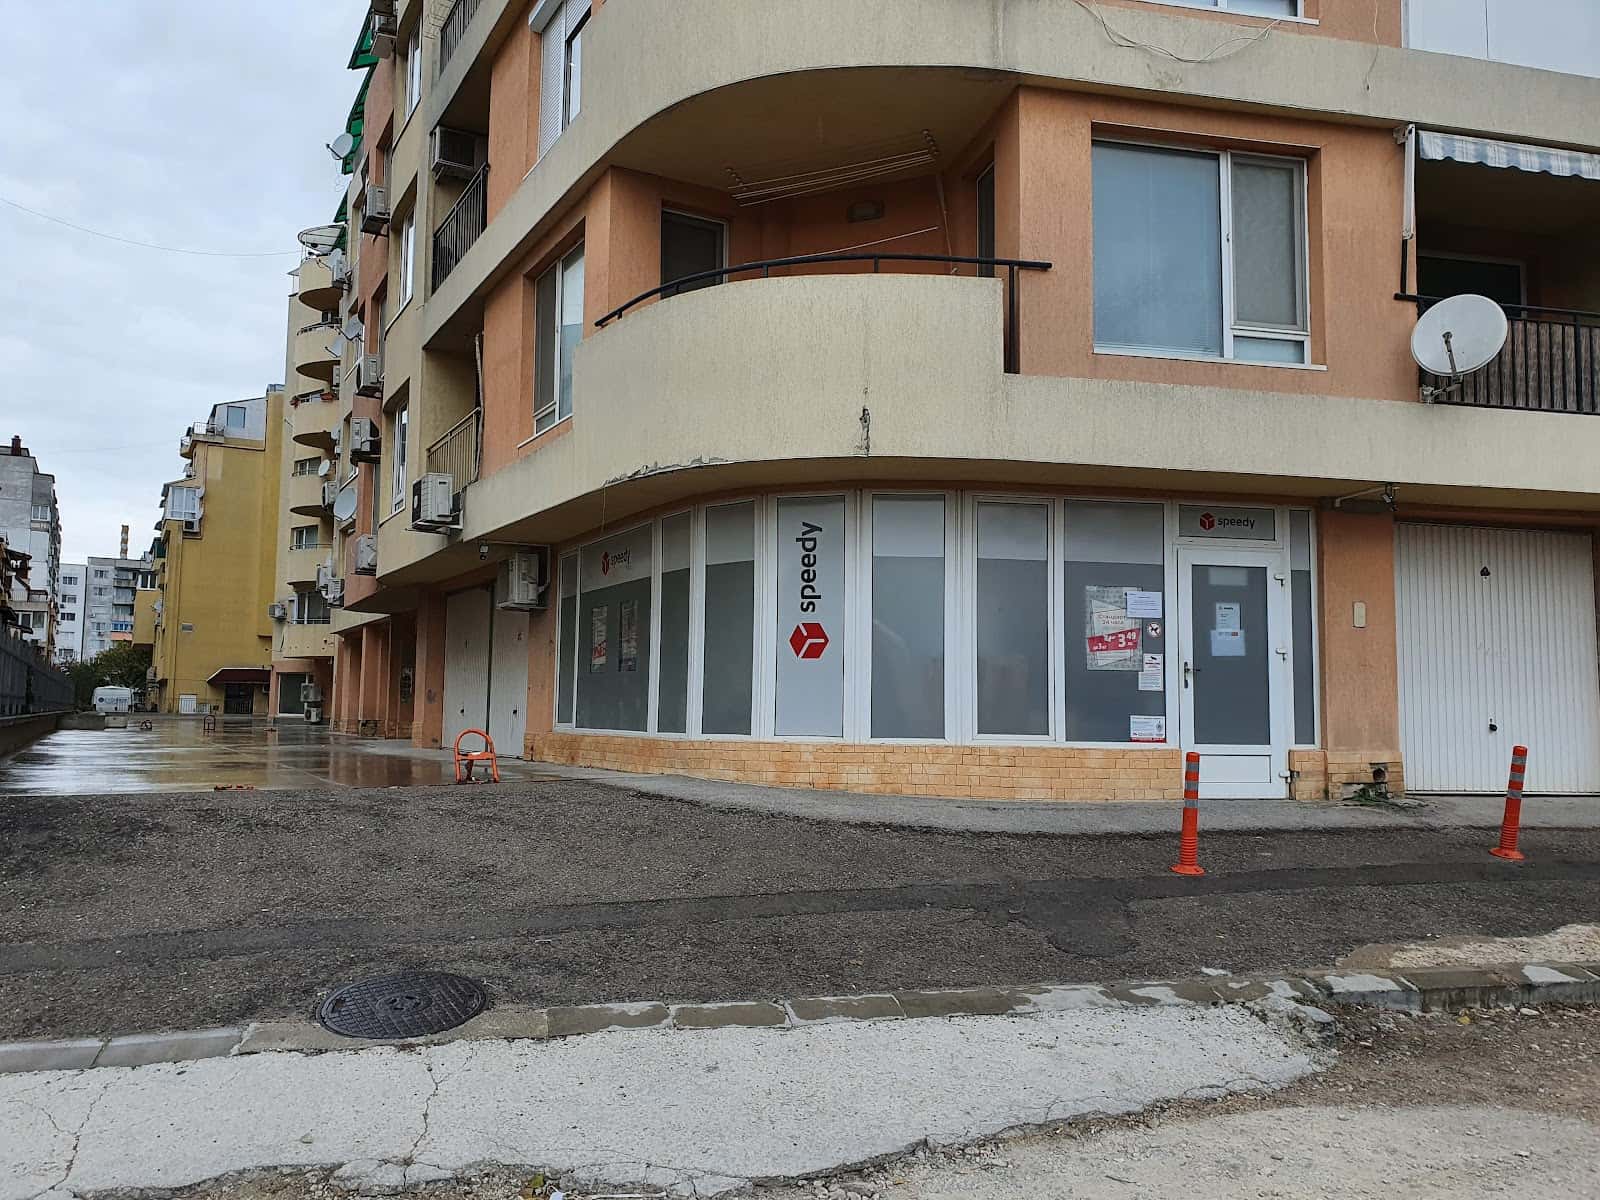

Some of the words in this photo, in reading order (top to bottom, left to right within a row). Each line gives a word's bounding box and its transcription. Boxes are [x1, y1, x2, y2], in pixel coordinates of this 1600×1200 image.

[1217, 516, 1256, 529] speedy
[611, 547, 631, 567] speedy
[795, 521, 823, 613] speedy
